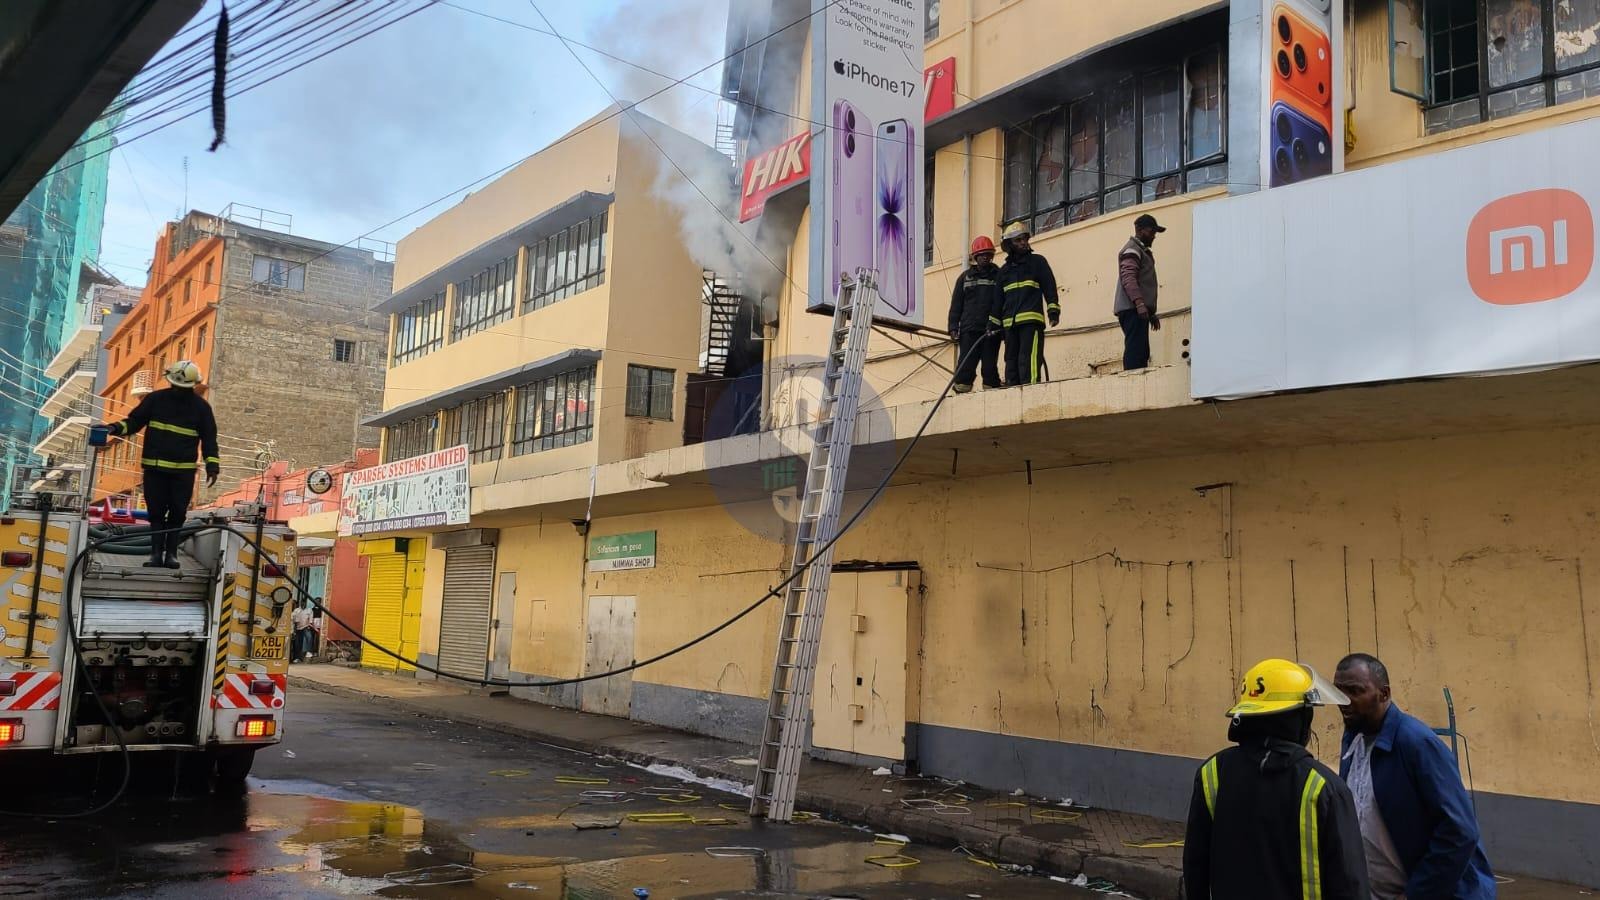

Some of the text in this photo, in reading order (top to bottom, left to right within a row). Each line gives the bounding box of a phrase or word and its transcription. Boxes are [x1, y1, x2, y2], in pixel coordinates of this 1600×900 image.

[840, 5, 849, 15] 24
[850, 11, 878, 26] months
[882, 11, 900, 22] mind
[902, 18, 915, 28] with
[834, 16, 914, 50] Look for the Redington
[863, 39, 886, 52] sticker
[847, 62, 898, 93] iPhone
[901, 80, 915, 98] 17
[352, 447, 466, 486] SPARSEC SYSTEMS LIMITED
[635, 558, 651, 567] SHOP
[262, 636, 282, 648] KBL
[255, 648, 281, 658] 620T
